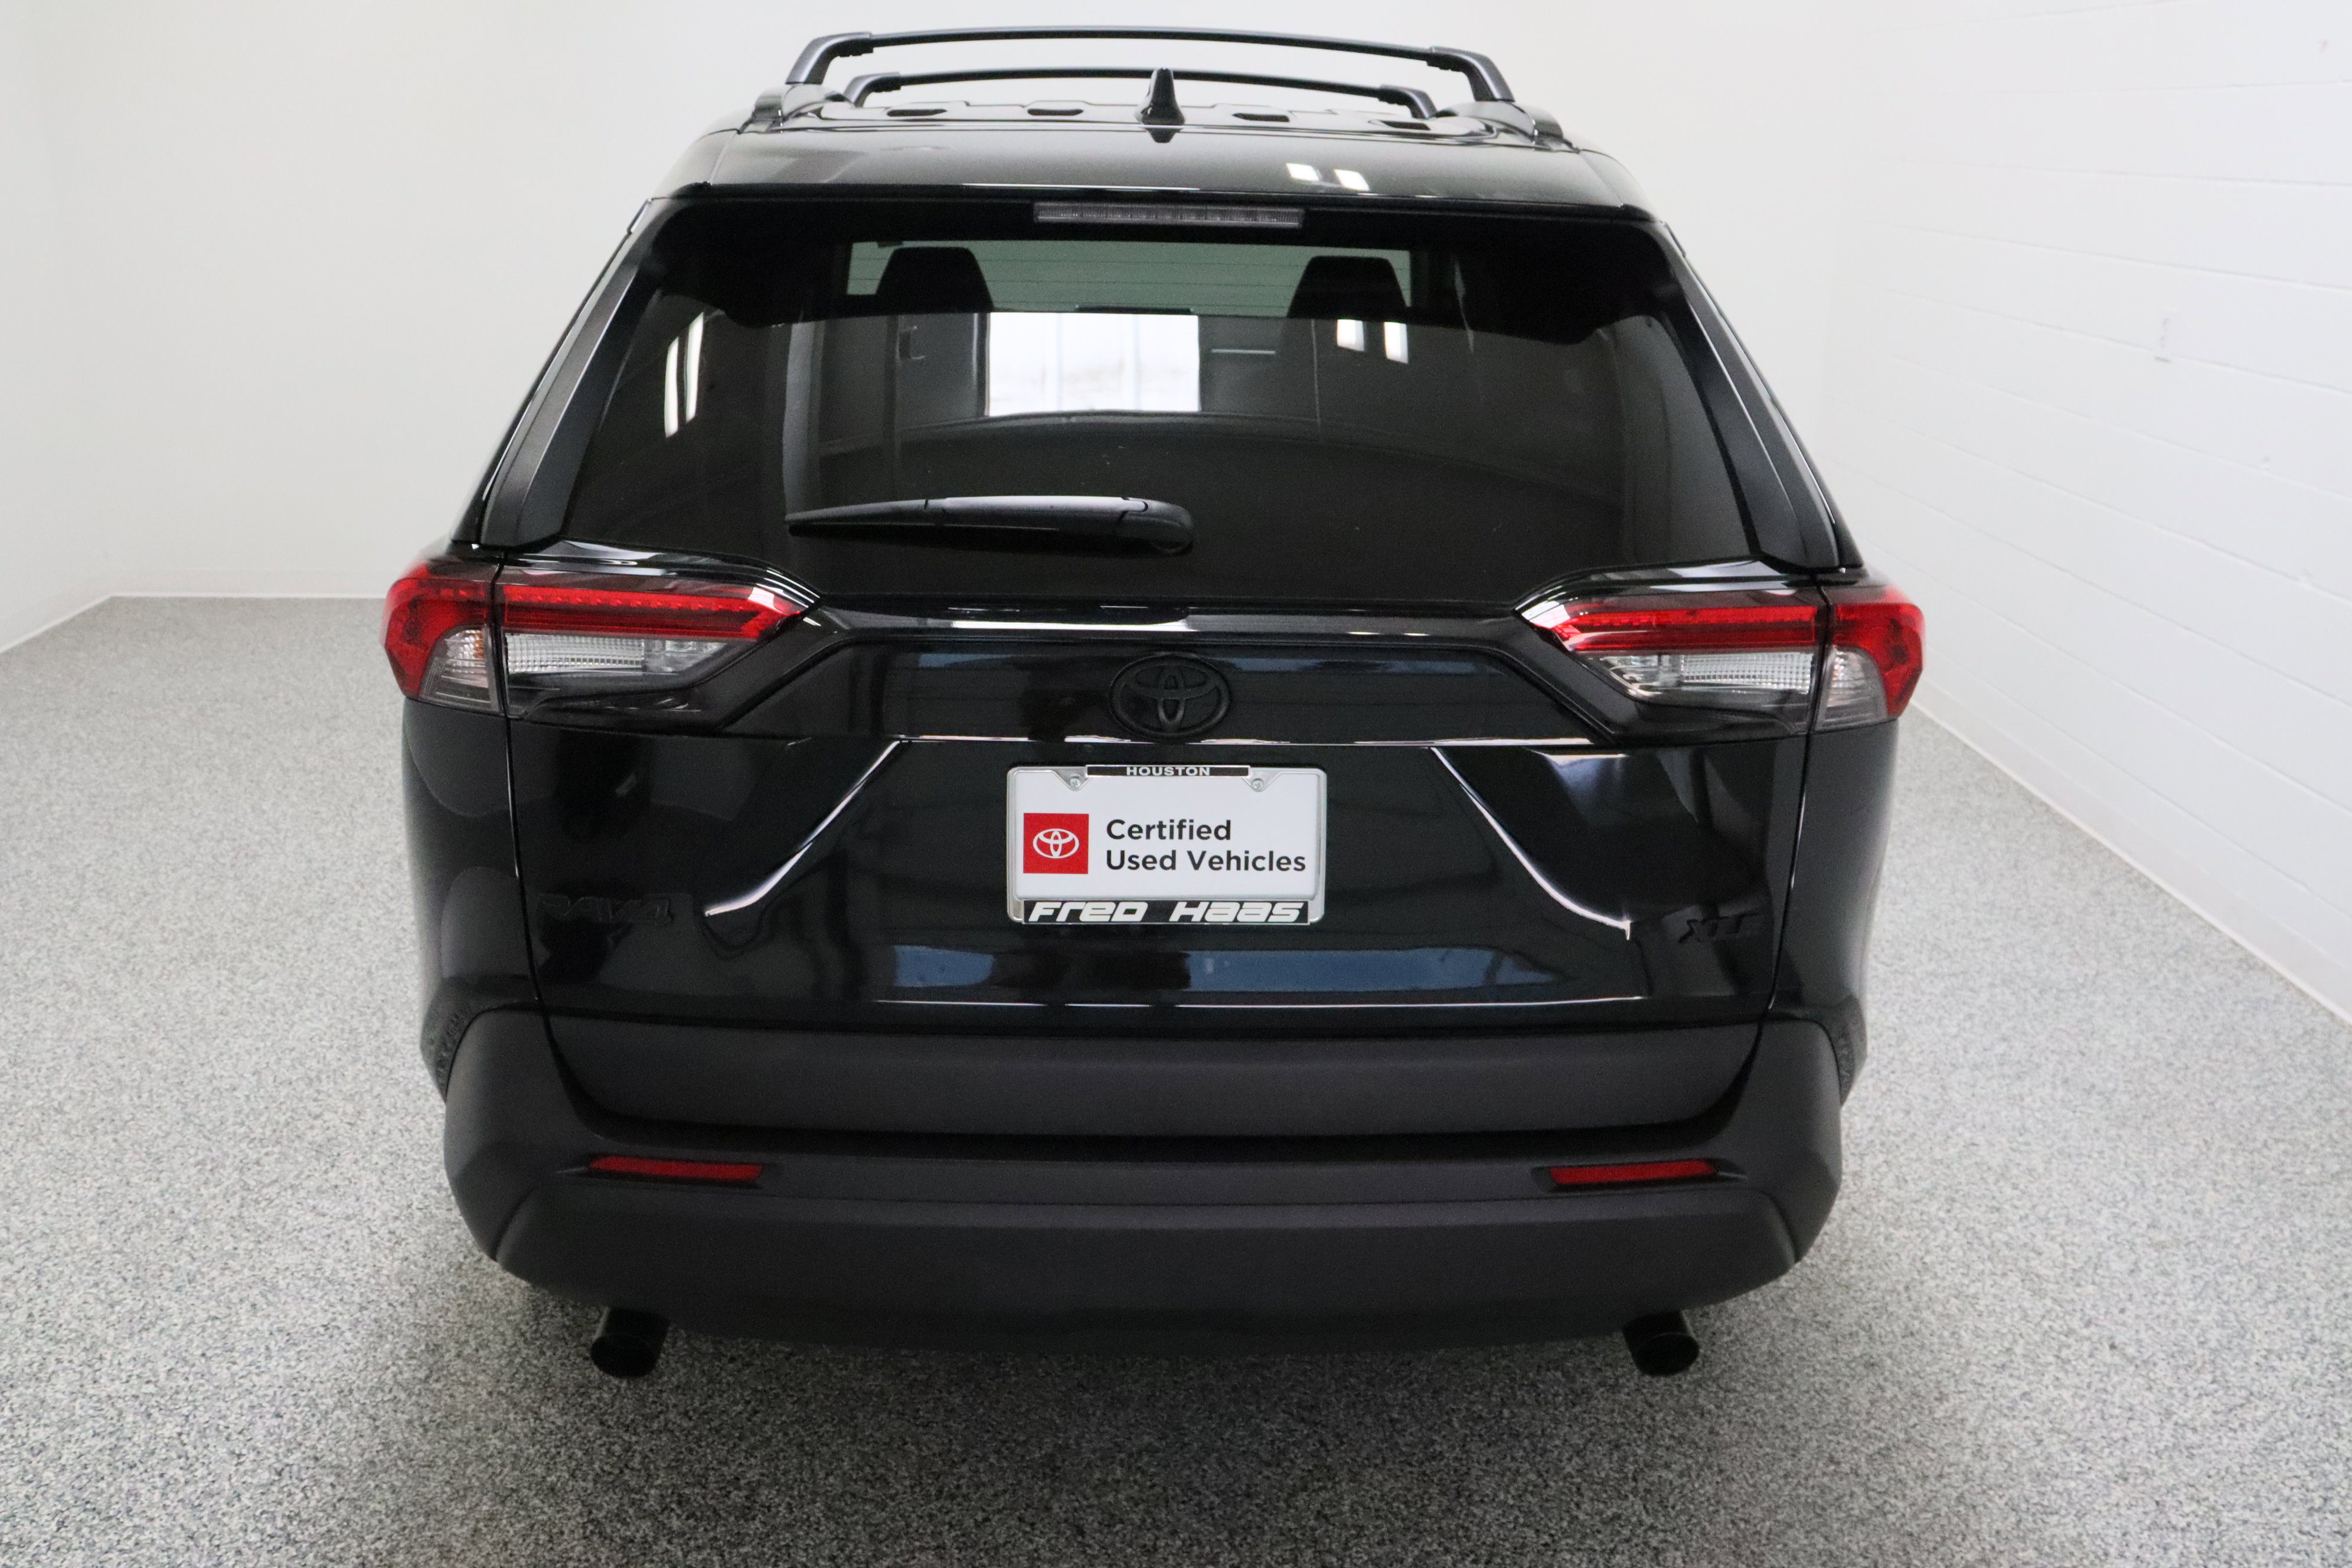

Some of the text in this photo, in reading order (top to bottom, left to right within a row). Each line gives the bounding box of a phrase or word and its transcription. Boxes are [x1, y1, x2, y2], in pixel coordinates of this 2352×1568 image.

[1125, 766, 1211, 776] HOUSTON
[1106, 819, 1231, 840] Certified
[1106, 850, 1306, 872] Used Vehicles
